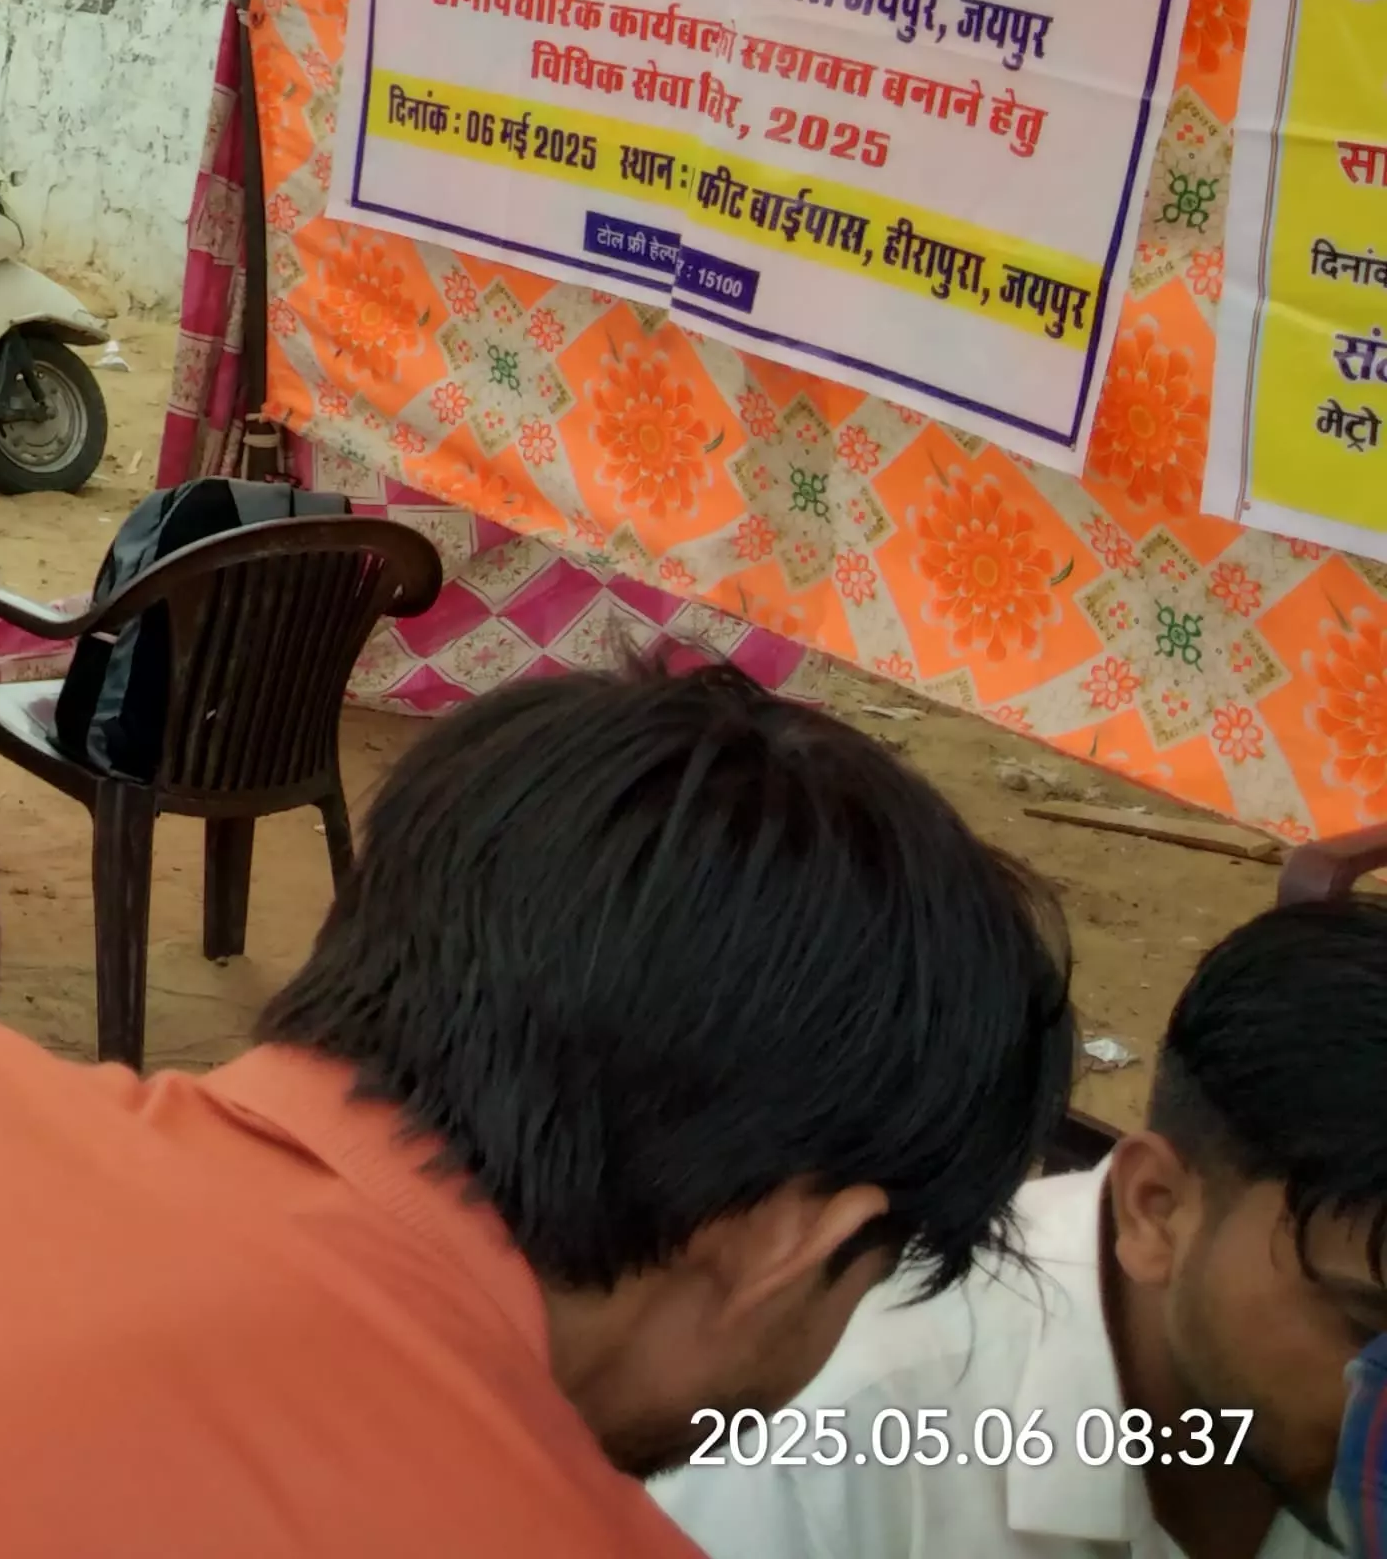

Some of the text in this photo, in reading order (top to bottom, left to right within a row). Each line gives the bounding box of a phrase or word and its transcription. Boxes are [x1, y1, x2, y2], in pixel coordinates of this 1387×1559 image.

[531, 40, 627, 94] विधिक
[632, 59, 694, 109] सेवा
[764, 107, 891, 168] 2025
[740, 34, 879, 98] सशक्त
[882, 68, 985, 128] बनाने
[989, 87, 1049, 158] हेतु
[466, 110, 494, 147] 06
[500, 112, 531, 160] मई
[534, 125, 598, 171] 2025
[619, 144, 675, 191] स्थान
[696, 165, 749, 219] फीट
[750, 188, 874, 267] बाईपास,
[883, 218, 991, 306] हीरापुरा,
[999, 263, 1090, 339] जयपुर
[597, 224, 624, 250] टोल
[698, 268, 744, 298] 15100
[1316, 398, 1383, 452] मेट्रो
